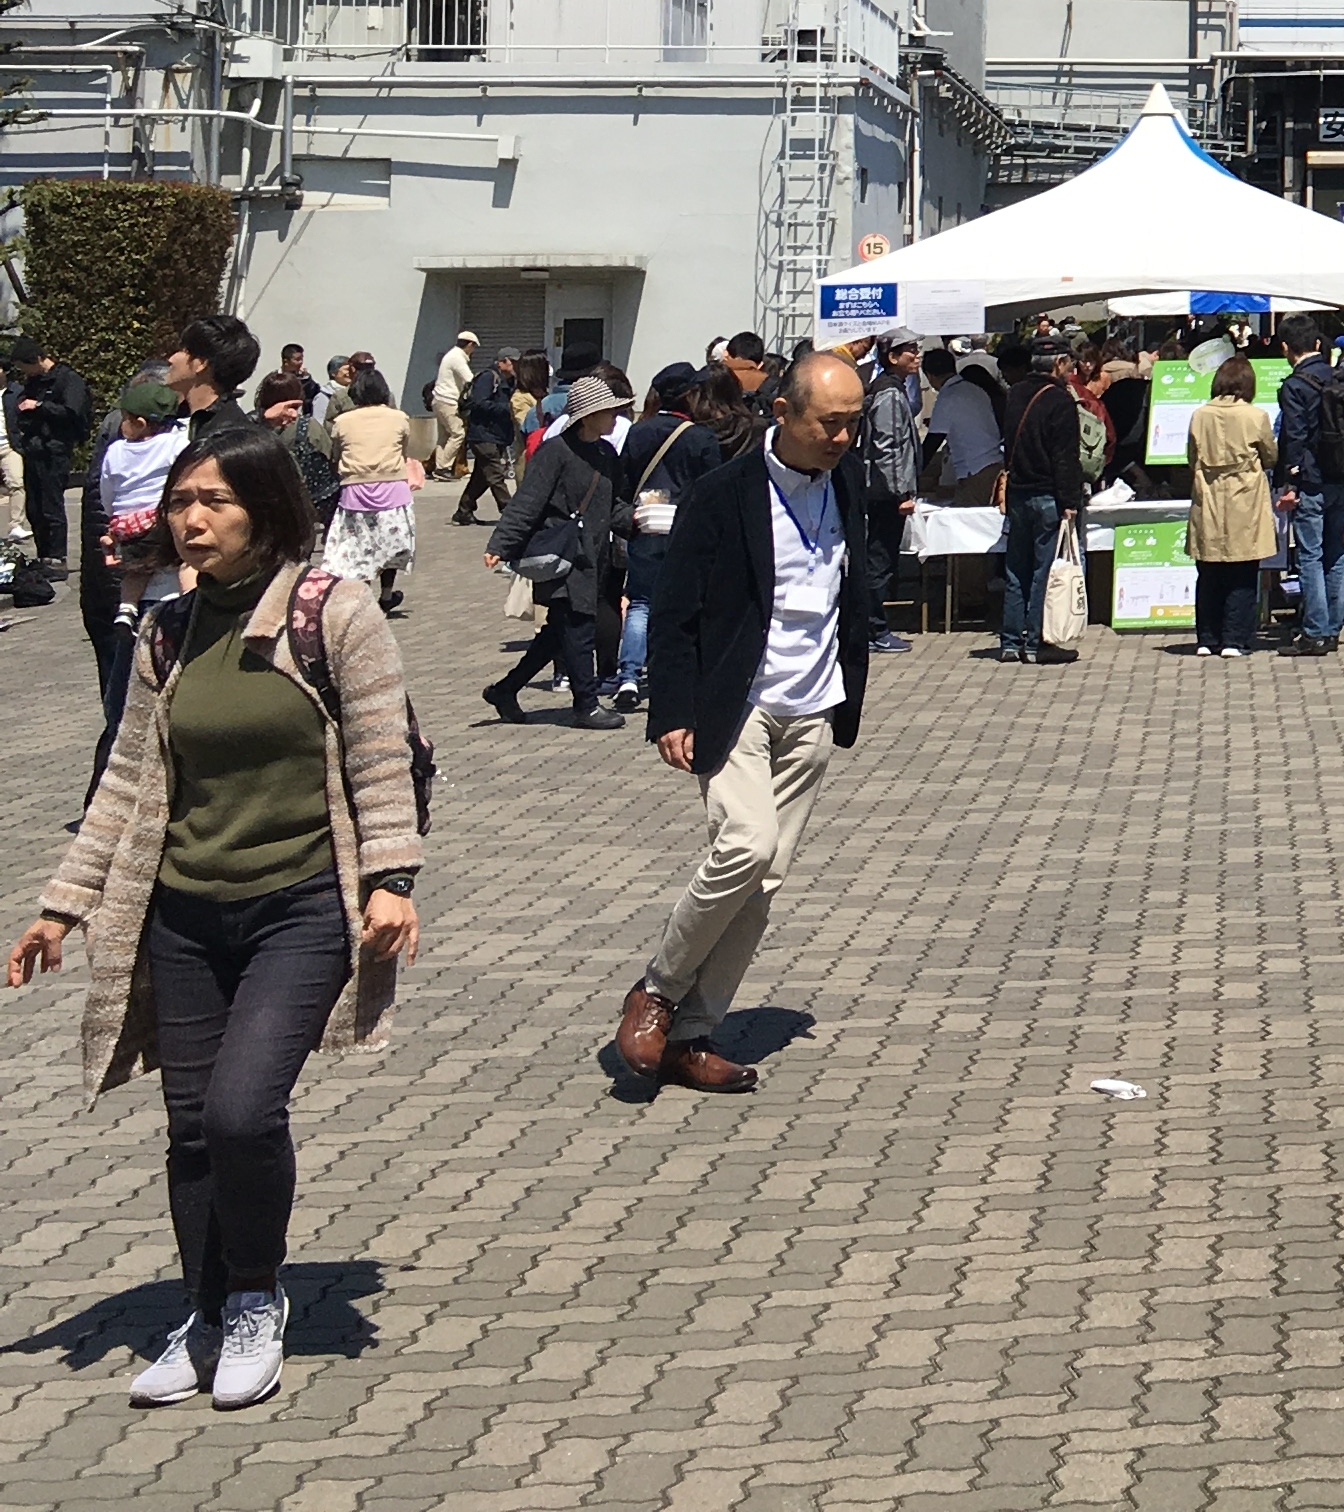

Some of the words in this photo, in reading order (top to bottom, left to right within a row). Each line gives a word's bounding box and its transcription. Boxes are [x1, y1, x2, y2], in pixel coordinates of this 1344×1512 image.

[866, 242, 883, 255] 15
[834, 287, 883, 300] 総合受付
